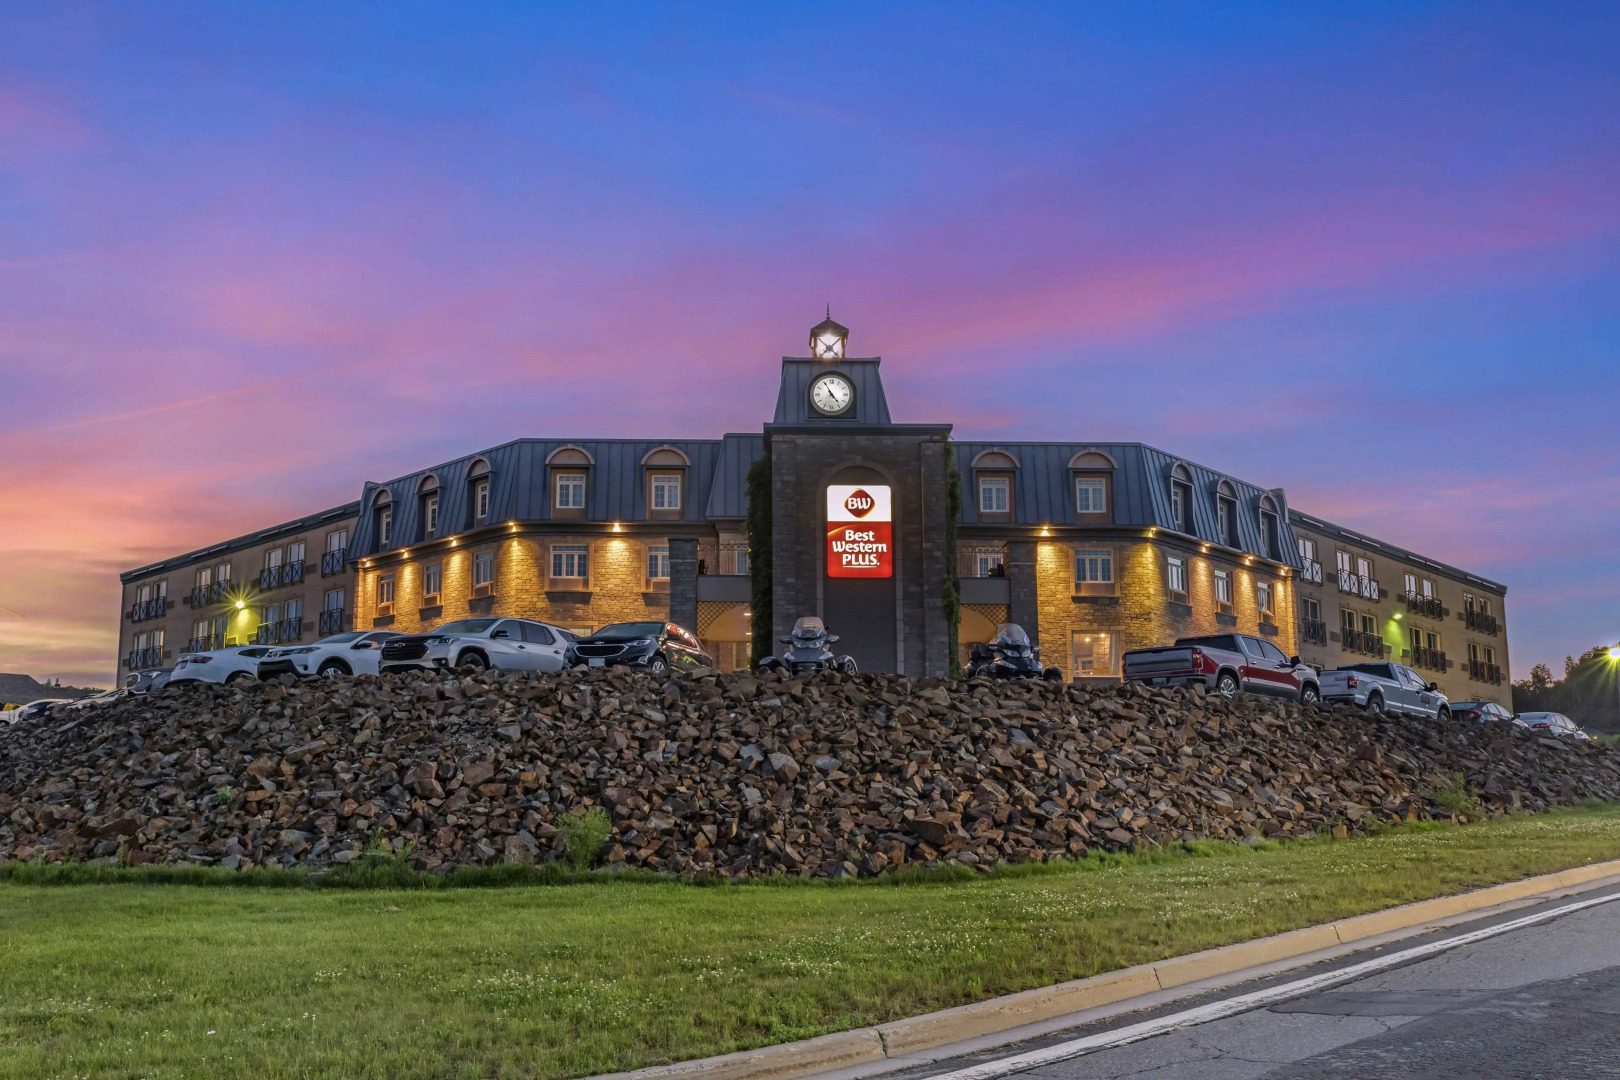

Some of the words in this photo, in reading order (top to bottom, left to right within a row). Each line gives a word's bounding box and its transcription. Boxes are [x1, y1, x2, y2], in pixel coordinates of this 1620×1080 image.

[847, 497, 871, 509] BW
[845, 529, 875, 541] Best
[832, 541, 887, 552] Western
